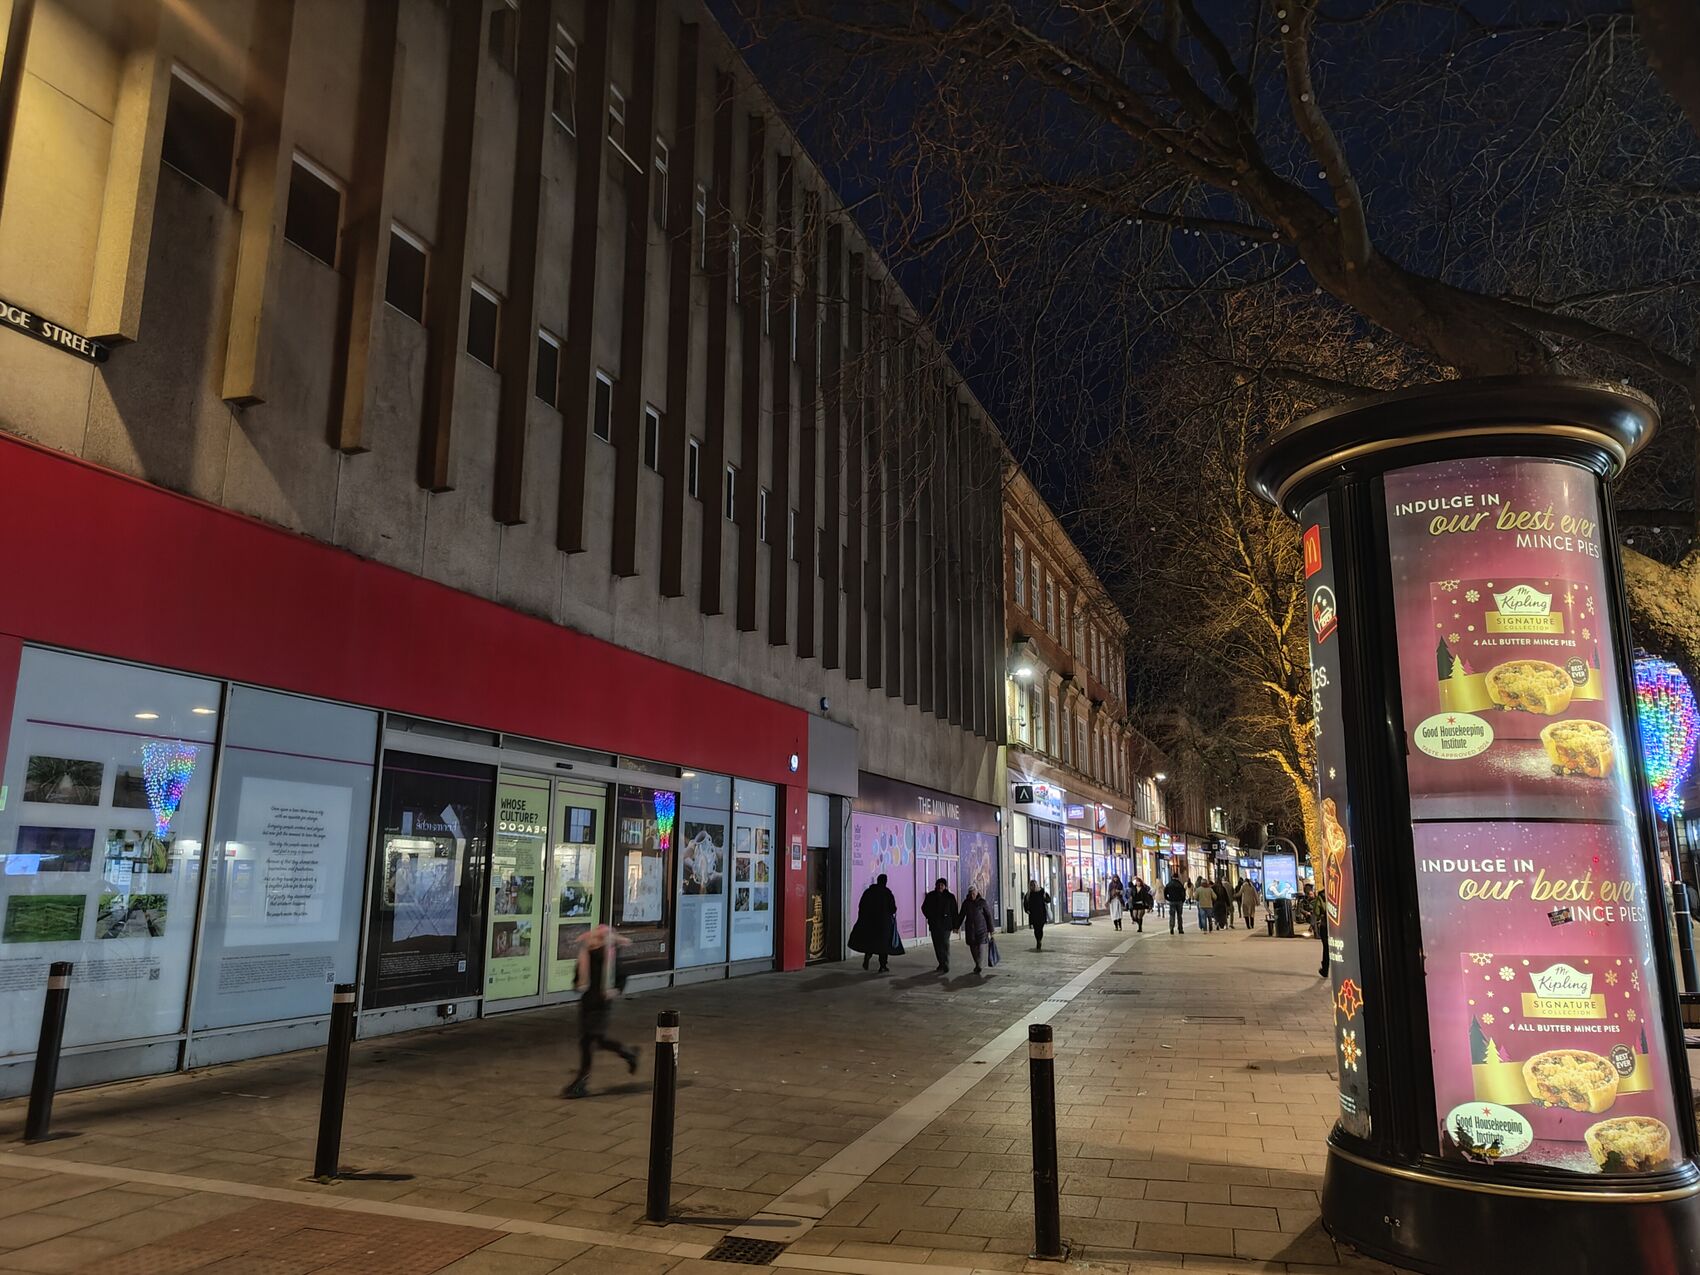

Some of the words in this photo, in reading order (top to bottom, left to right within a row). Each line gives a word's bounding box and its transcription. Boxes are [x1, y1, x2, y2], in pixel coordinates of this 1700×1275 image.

[42, 321, 100, 358] STREET
[1395, 495, 1474, 516] INDULGE
[1481, 494, 1500, 506] IN
[1429, 511, 1490, 536] our
[1496, 500, 1556, 530] best
[1560, 514, 1596, 540] ever
[1516, 534, 1574, 552] MINCE
[1578, 539, 1600, 559] PIES
[1501, 595, 1548, 612] Kipling
[1422, 726, 1438, 738] Good
[1440, 724, 1484, 737] Housekeeping
[1422, 745, 1439, 756] TASTE
[1442, 738, 1468, 749] Institute
[501, 798, 526, 810] WHOSE
[918, 796, 931, 814] THE
[932, 800, 946, 817] MINI
[500, 810, 538, 823] CULTURE?
[1422, 859, 1507, 872] INDULGE
[1514, 859, 1534, 872] IN
[1458, 878, 1524, 900] our
[1530, 868, 1594, 901] best
[1553, 906, 1615, 922] INCE
[1620, 906, 1643, 922] PIES
[1538, 975, 1588, 994] Kipling
[1537, 1024, 1572, 1032] BUTTER
[1615, 1053, 1628, 1062] BEST
[1616, 1060, 1631, 1069] EVER
[1475, 1116, 1522, 1134] Housekeeping
